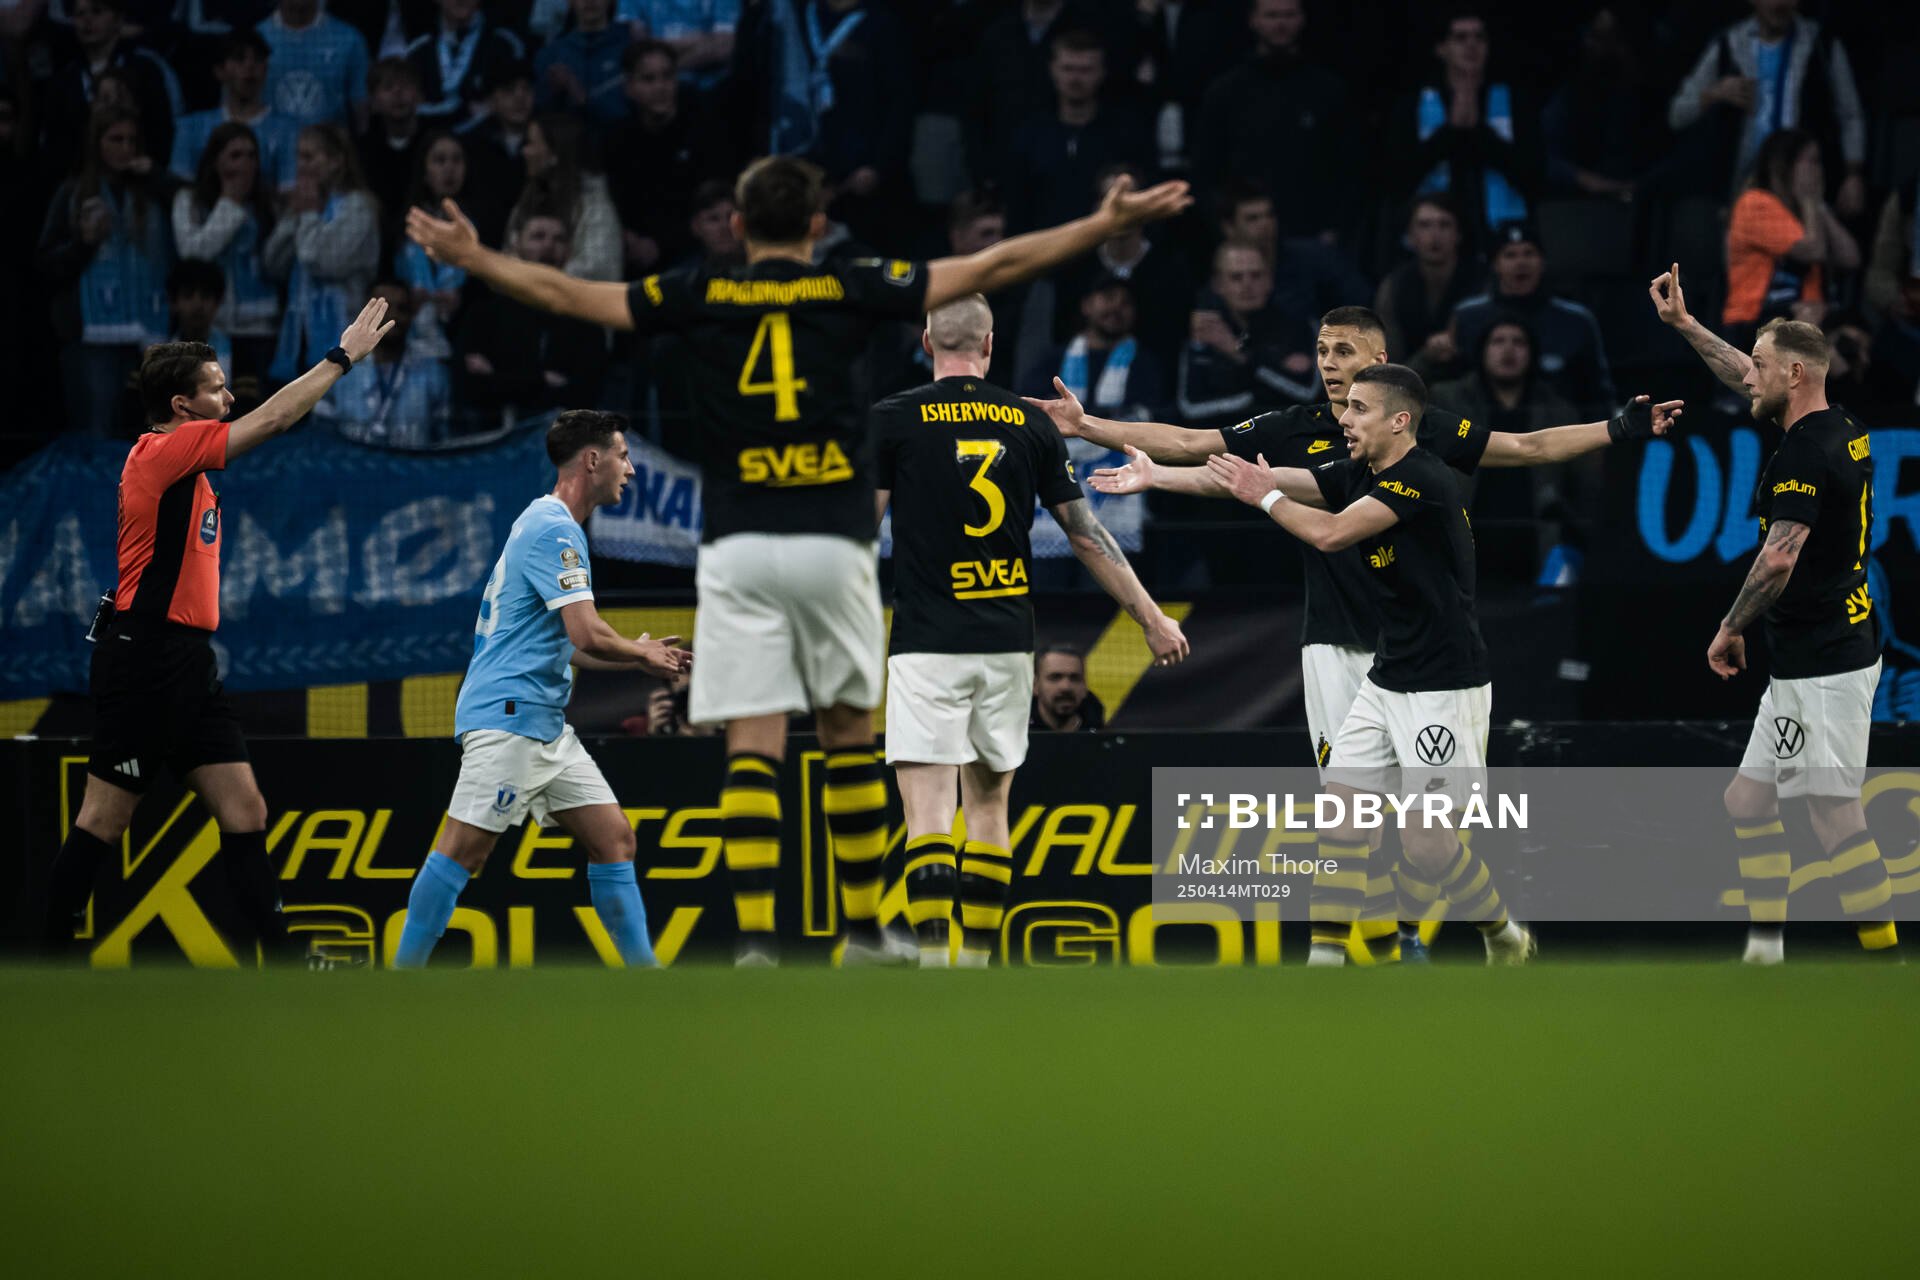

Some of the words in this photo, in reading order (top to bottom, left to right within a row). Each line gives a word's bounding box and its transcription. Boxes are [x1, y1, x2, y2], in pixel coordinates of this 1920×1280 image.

[738, 312, 807, 421] 4
[920, 402, 1026, 426] ISHERWOOD
[738, 439, 854, 487] SVEA
[955, 438, 1007, 537] 3
[1773, 479, 1816, 496] sadium
[951, 558, 1029, 590] SVEA
